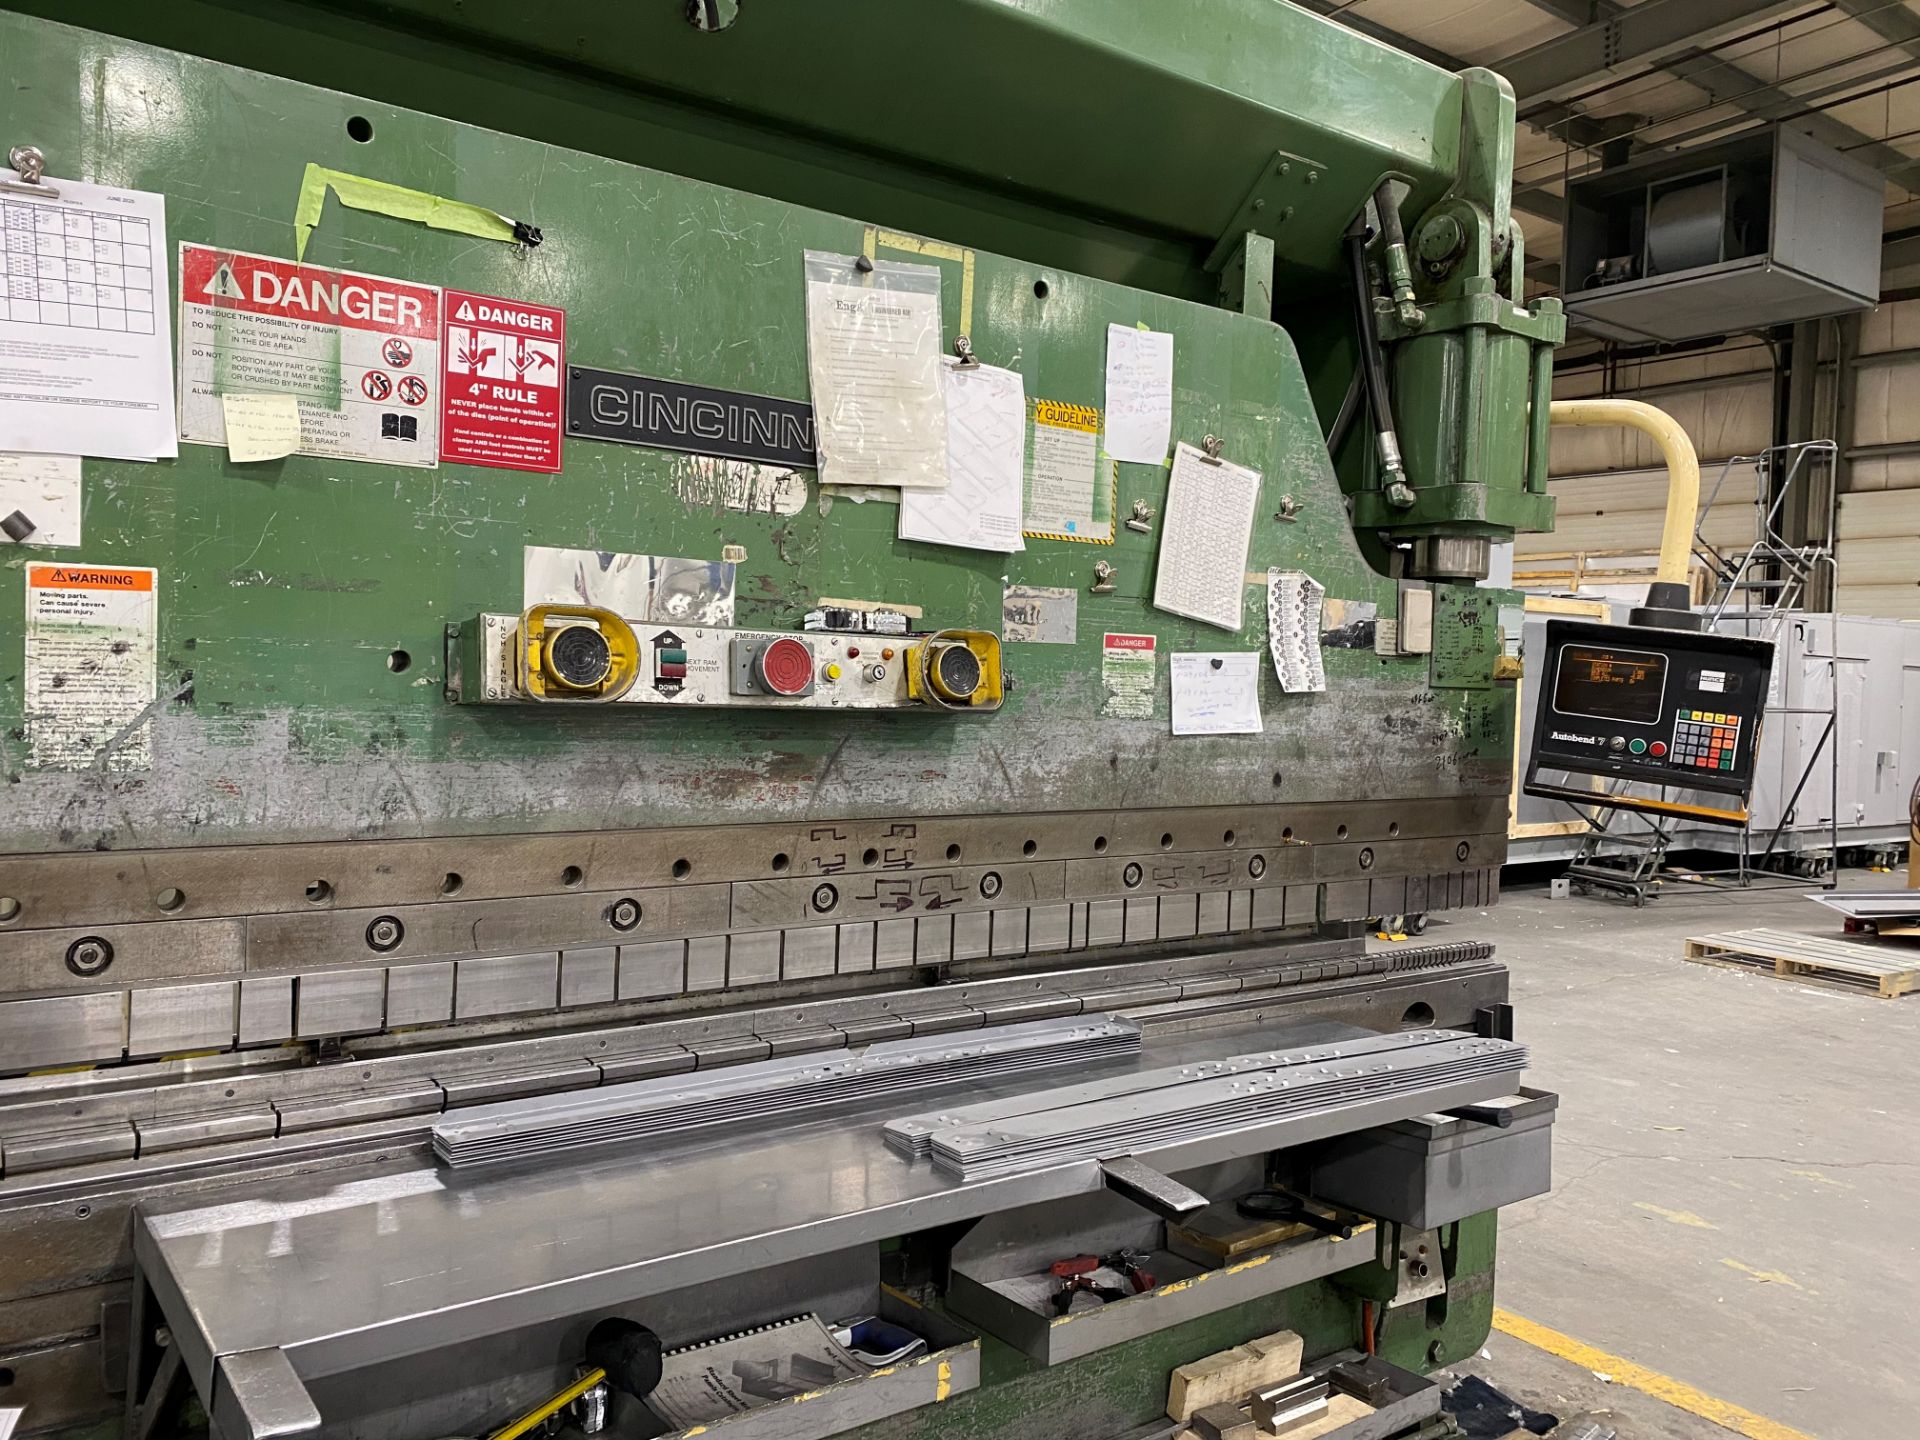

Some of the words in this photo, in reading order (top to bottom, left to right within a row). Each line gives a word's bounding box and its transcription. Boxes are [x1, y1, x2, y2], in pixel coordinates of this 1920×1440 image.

[252, 270, 422, 328] DANGER
[193, 307, 204, 315] TO
[206, 309, 237, 320] REDUCE
[238, 314, 254, 322] THE
[255, 316, 300, 330] POSSIBILITY
[313, 326, 338, 335] INJURY
[478, 306, 553, 332] DANGER
[192, 321, 204, 329] DO
[206, 323, 222, 332] NOT
[257, 330, 279, 340] YOUR
[281, 333, 307, 344] HANDS
[242, 337, 257, 346] THE
[258, 340, 273, 348] DIE
[274, 341, 294, 351] AREA
[192, 349, 204, 357] DO
[206, 352, 222, 360] NOT
[231, 354, 266, 366] POSITION
[268, 360, 284, 369] ANY
[286, 362, 304, 370] PART
[231, 364, 252, 373] BODY
[254, 367, 280, 377] WHERE
[291, 372, 307, 380] MAY
[309, 374, 319, 382] BE
[231, 373, 243, 381] OR
[244, 375, 280, 386] CRUSHED
[293, 381, 312, 390] PART
[192, 387, 223, 397] ALWAY
[469, 383, 488, 396] 4"
[493, 386, 538, 404] RULE
[451, 398, 477, 408] NEVER
[478, 402, 498, 411] place
[500, 406, 521, 414] hands
[522, 408, 544, 417] within
[300, 418, 324, 427] EFORE
[333, 413, 348, 421] AND
[457, 409, 469, 417] the
[487, 414, 509, 423] (point
[590, 384, 815, 453] CINCINN
[1046, 408, 1104, 429] GUIDELINES
[300, 427, 338, 437] PERATING
[470, 430, 494, 438] controls
[508, 434, 542, 444] combination
[315, 438, 339, 446] BRAKE
[452, 437, 474, 445] clamps
[502, 442, 525, 451] controls
[1037, 473, 1063, 482] OPERATION
[68, 572, 134, 585] WARNING
[40, 591, 65, 599] Moving
[67, 592, 89, 600] parts.
[735, 632, 781, 642] EMERGENCY
[1120, 639, 1147, 648] DANGER
[1551, 731, 1595, 745] Autobend
[1598, 737, 1606, 746] 7
[707, 1366, 728, 1392] Standard
[725, 1389, 742, 1404] Sheet
